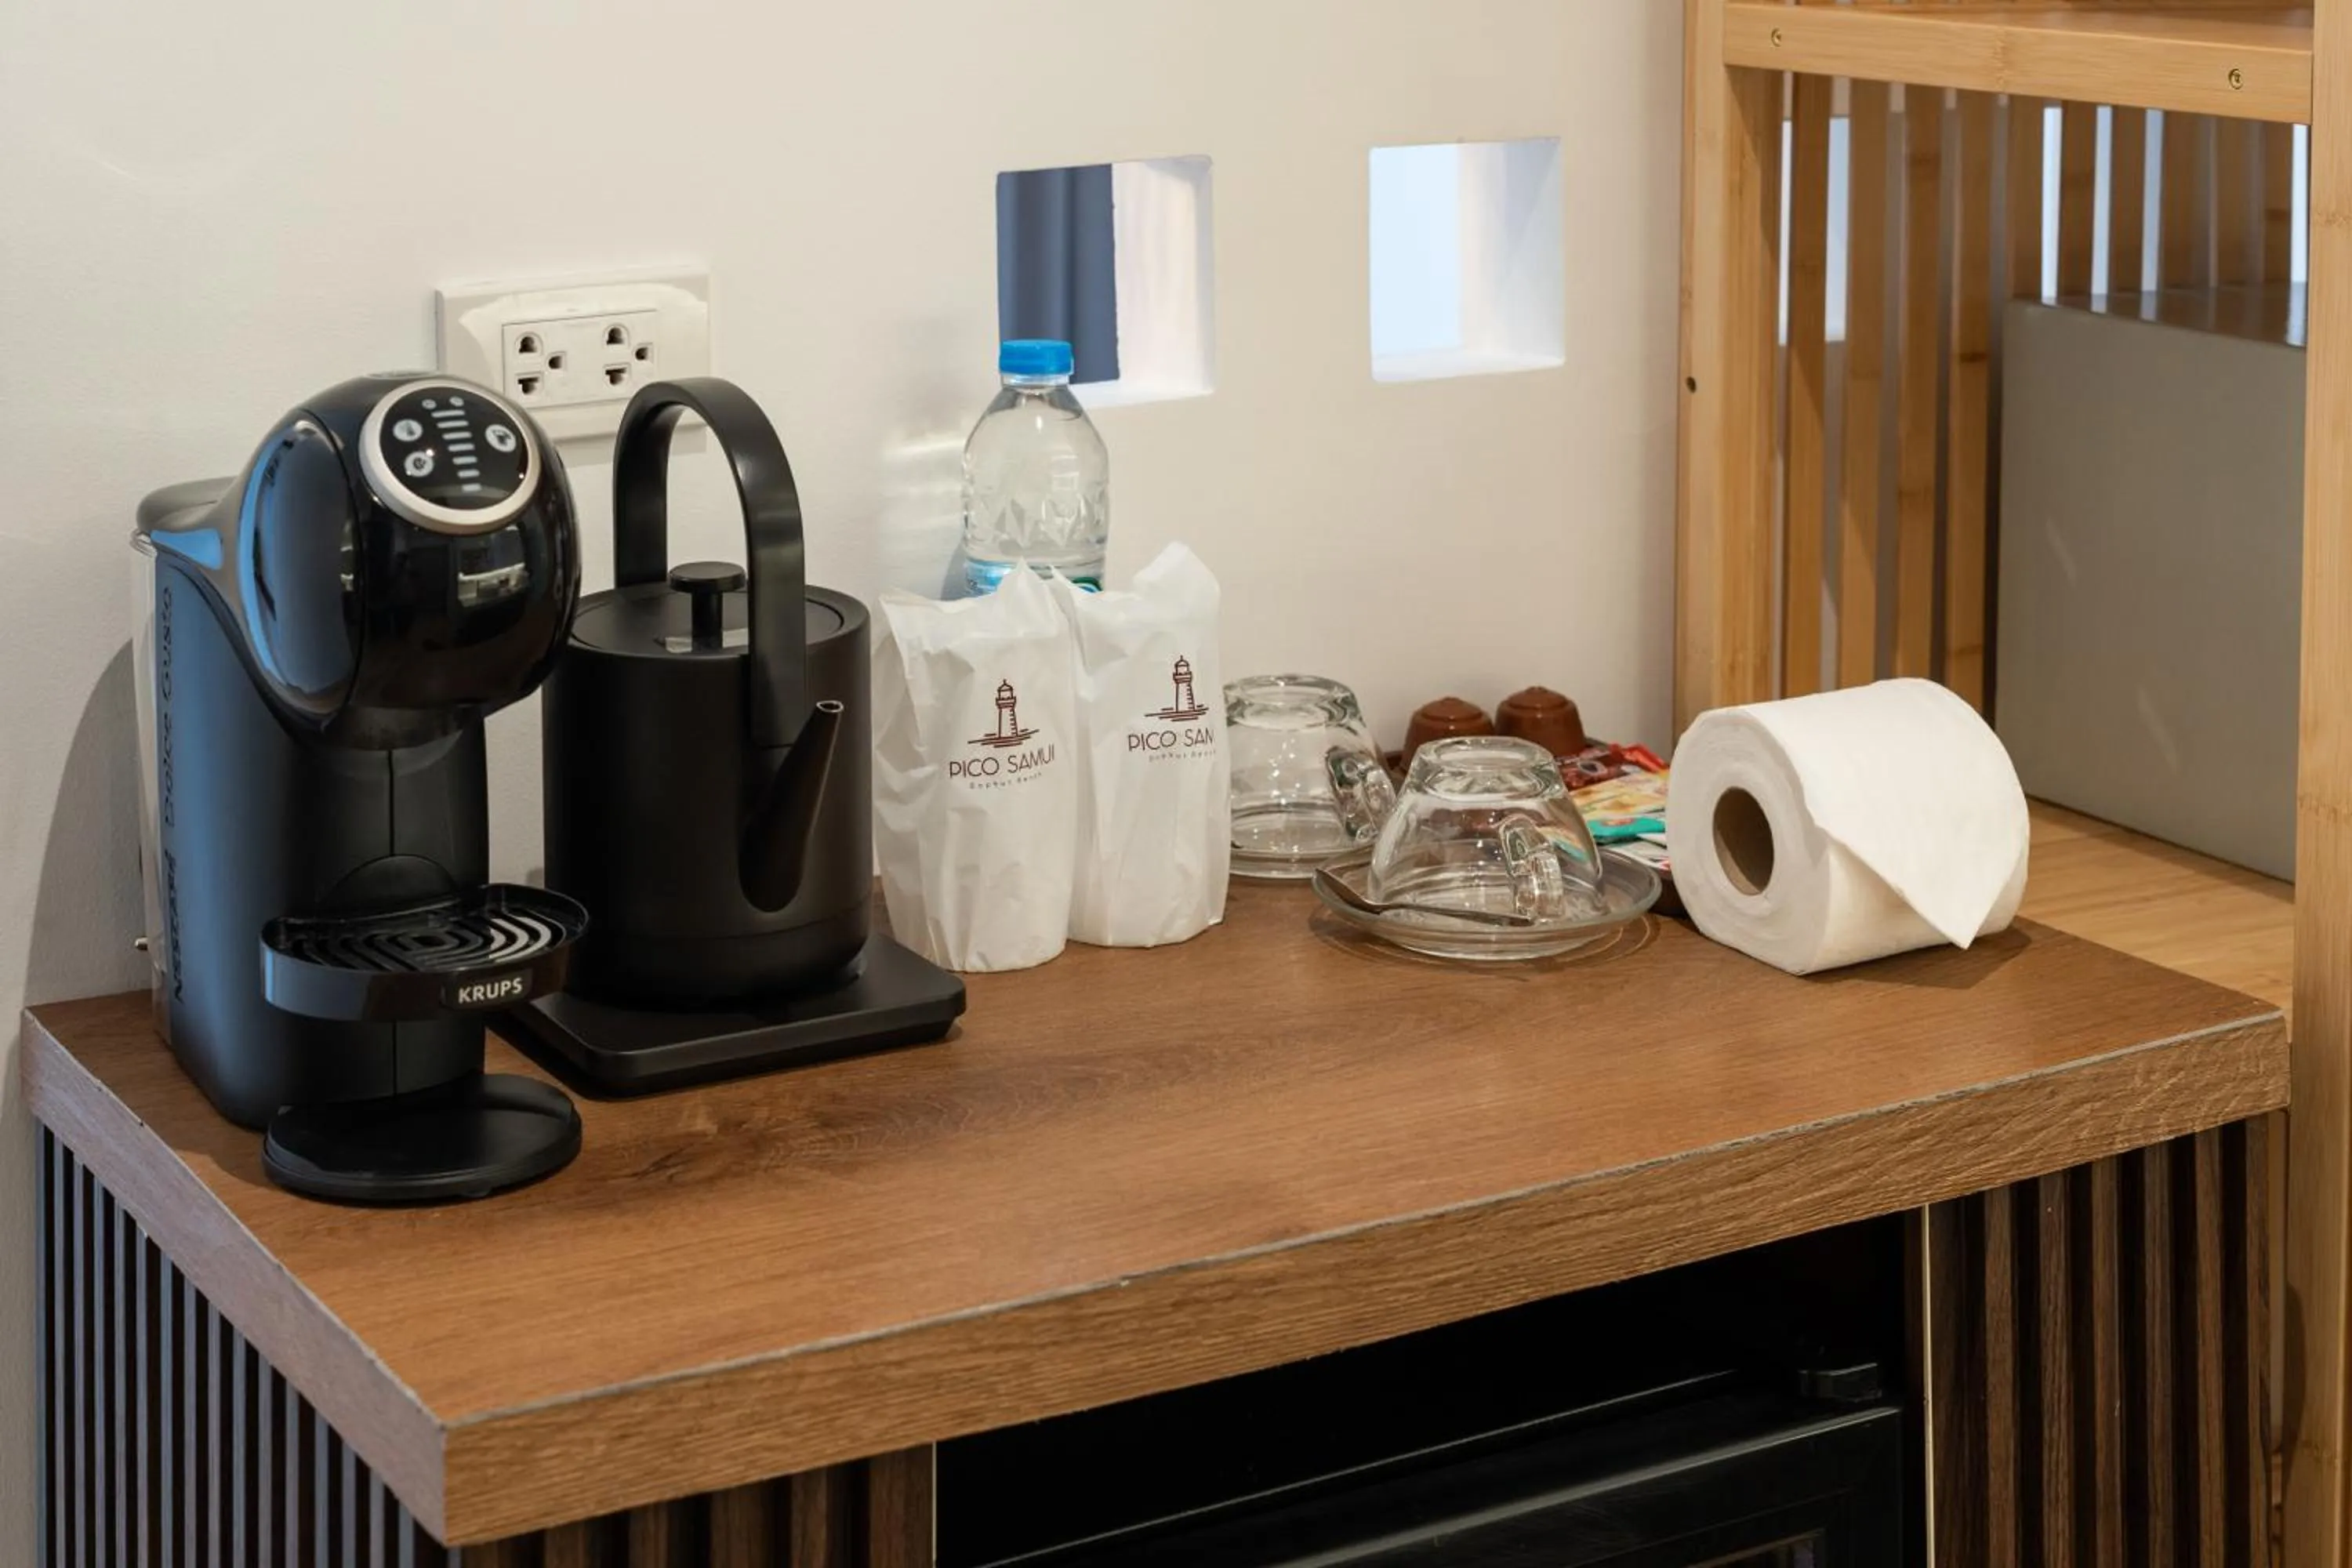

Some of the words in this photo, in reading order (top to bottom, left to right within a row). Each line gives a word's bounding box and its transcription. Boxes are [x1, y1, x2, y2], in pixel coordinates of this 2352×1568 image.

[1127, 731, 1177, 751] PICO
[949, 757, 1000, 778] PICO
[1007, 743, 1055, 773] SAMUI
[458, 977, 523, 1004] KRUPS
